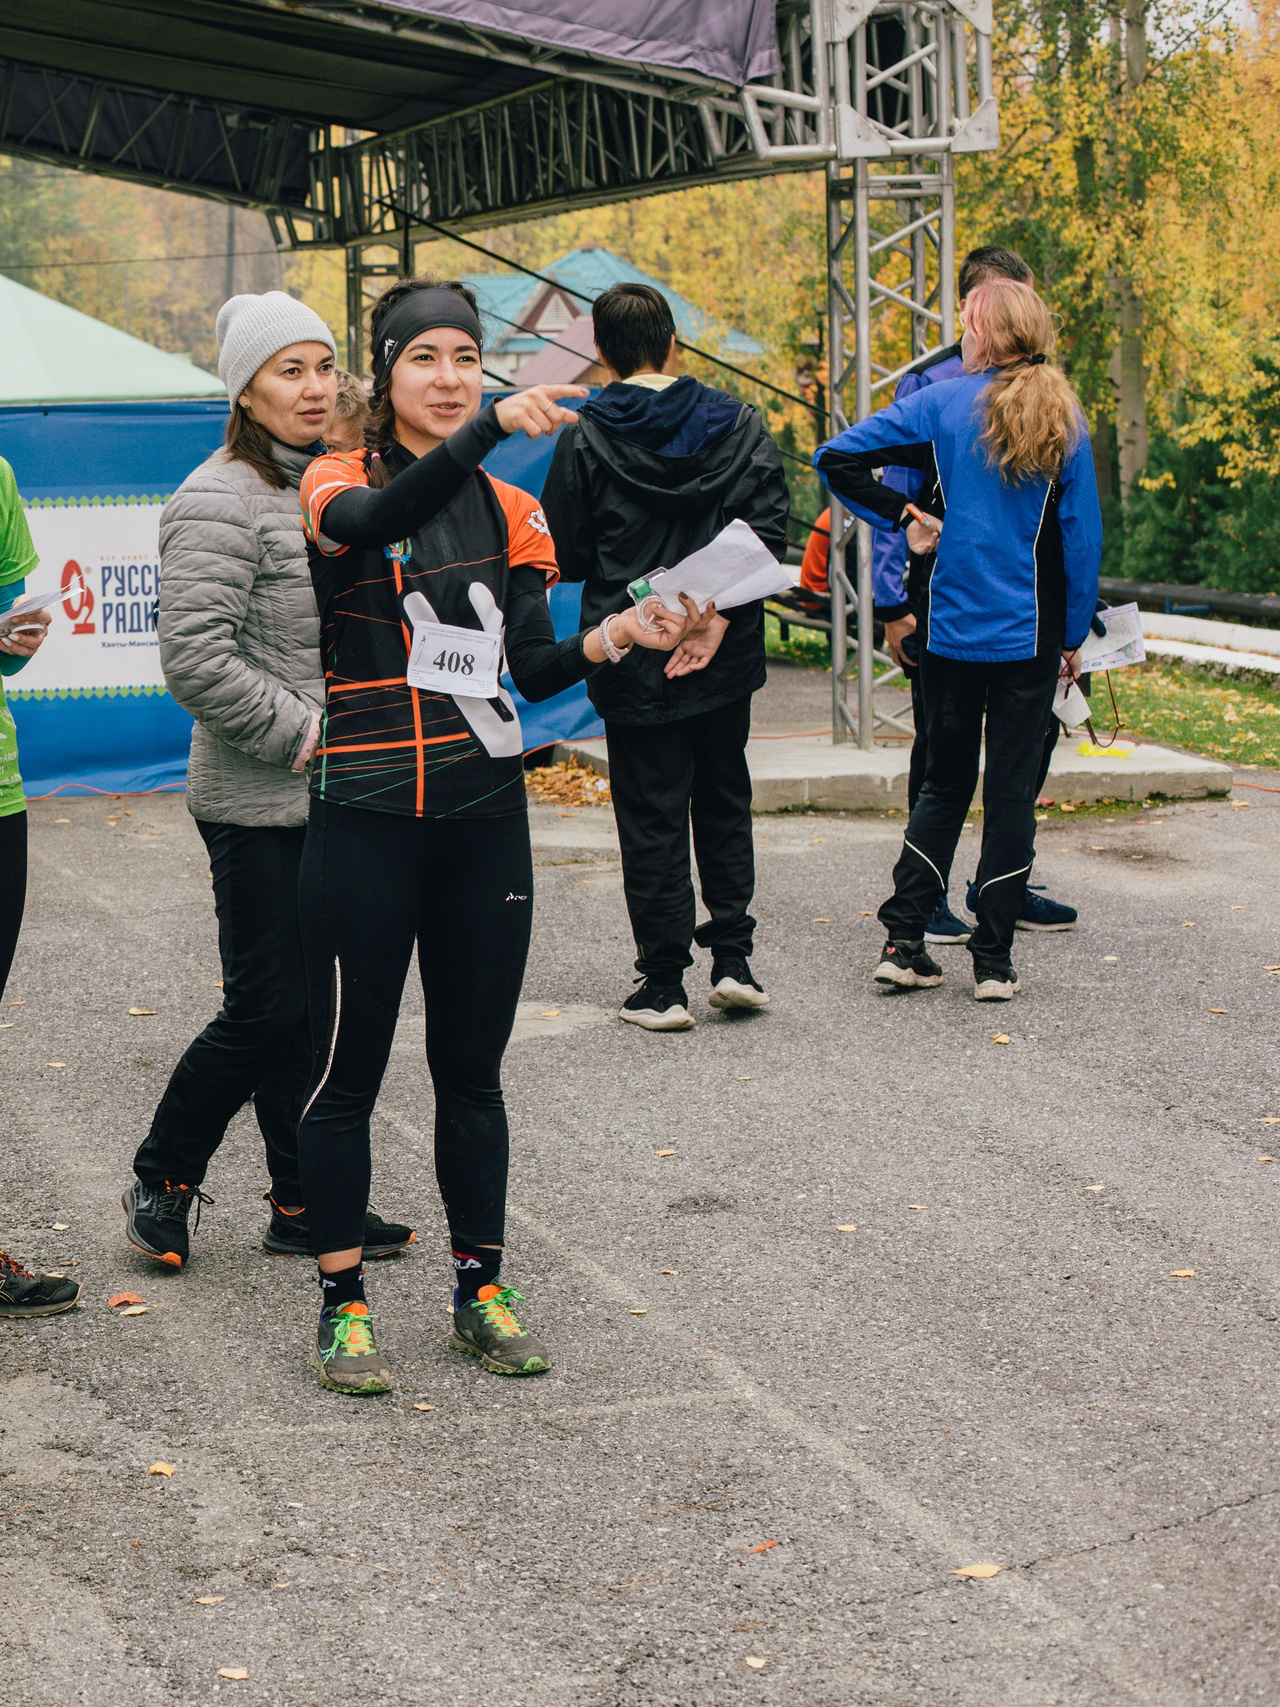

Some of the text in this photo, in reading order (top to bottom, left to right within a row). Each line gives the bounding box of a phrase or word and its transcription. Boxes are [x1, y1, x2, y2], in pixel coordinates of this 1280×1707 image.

[101, 564, 161, 597] РУССК
[102, 601, 156, 634] РАДИ
[101, 640, 159, 648] Ханты-Мансий
[433, 649, 475, 676] 408
